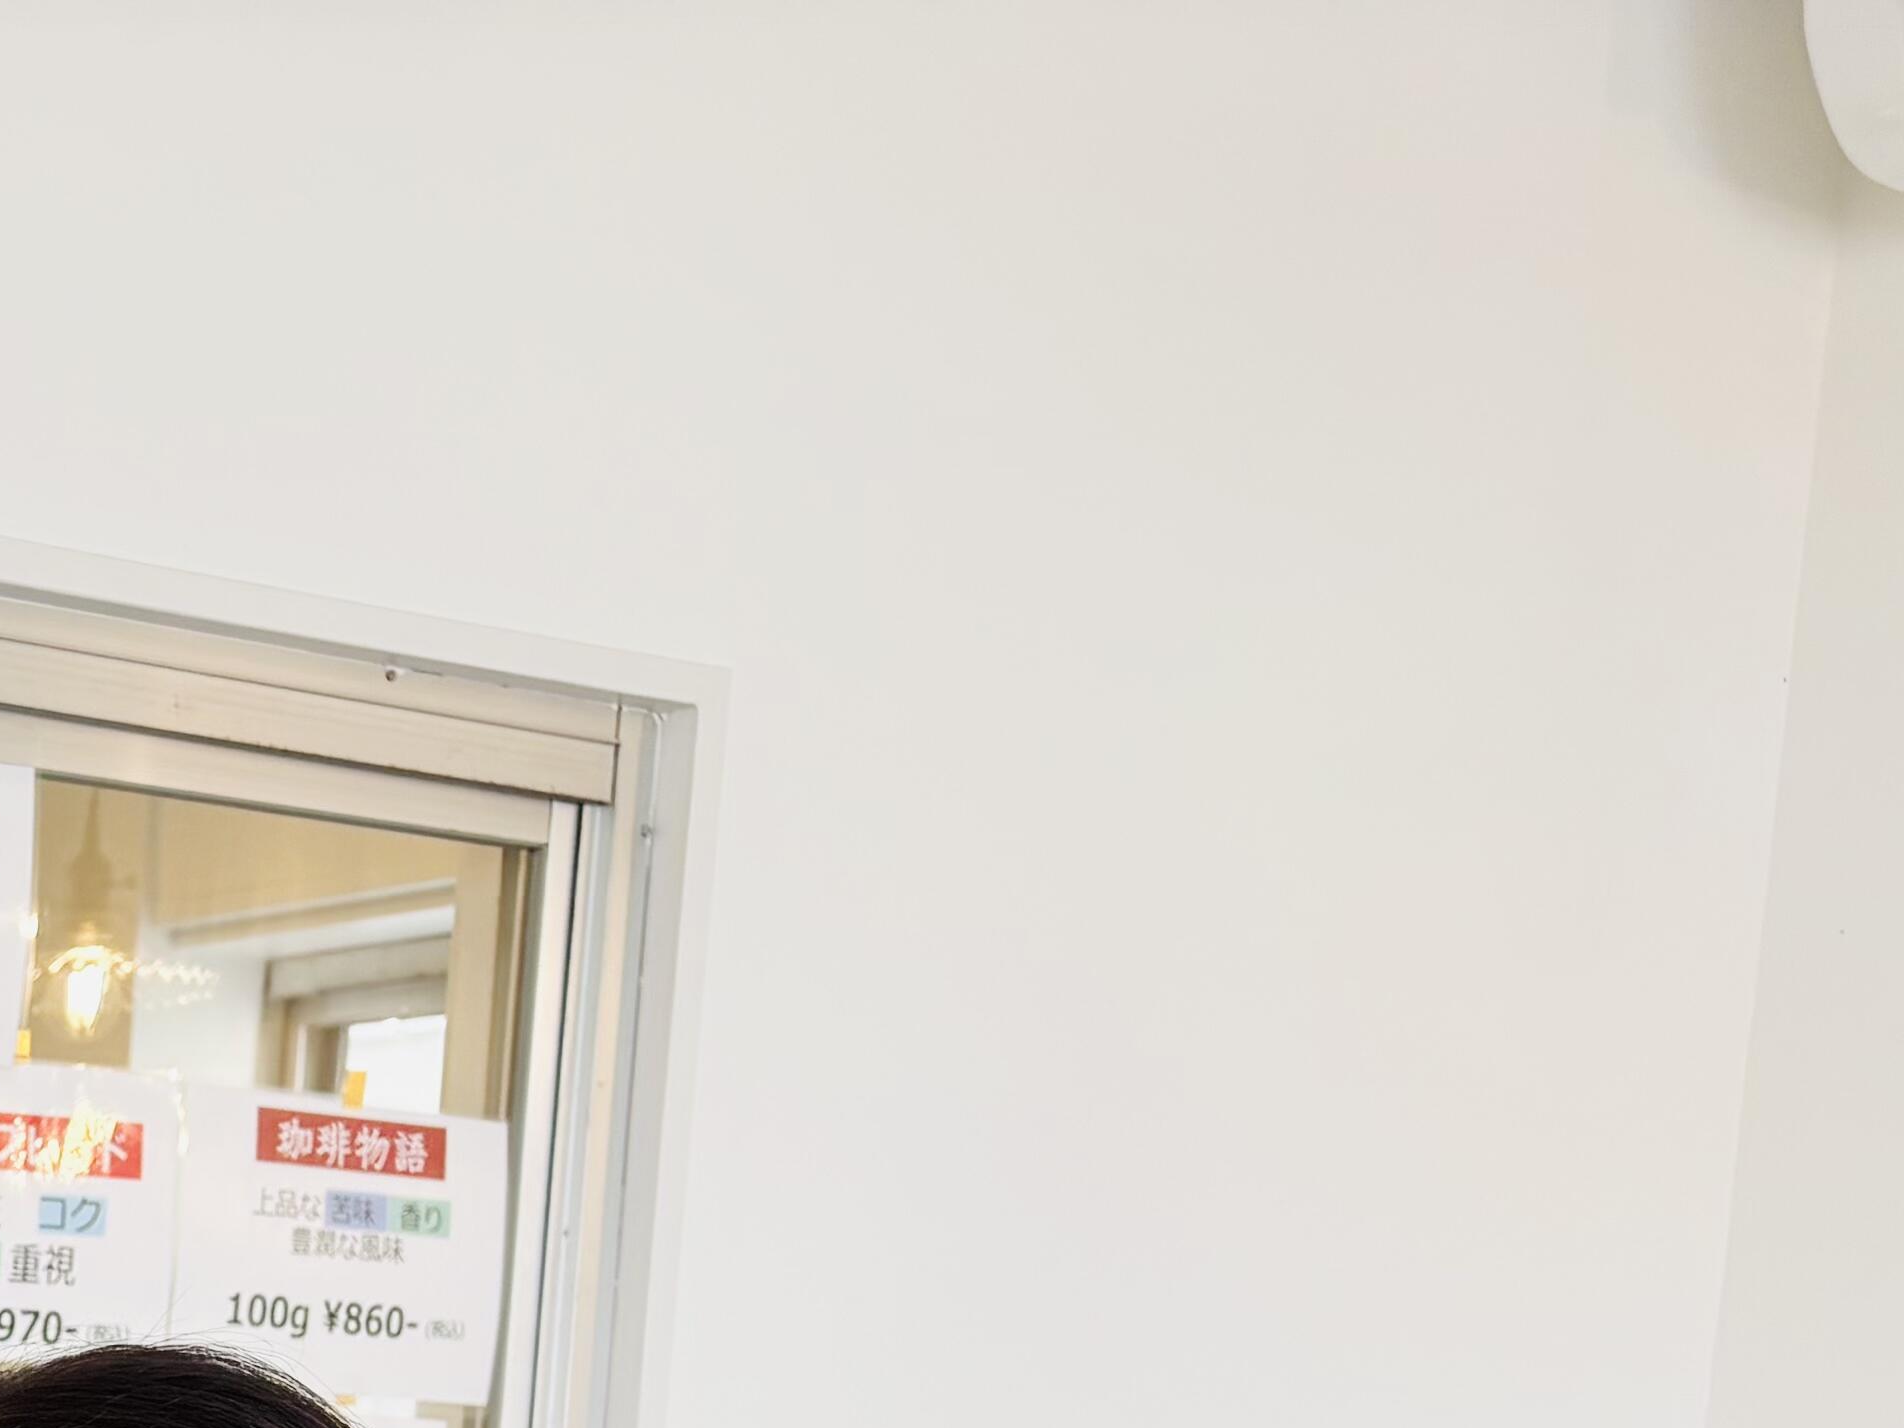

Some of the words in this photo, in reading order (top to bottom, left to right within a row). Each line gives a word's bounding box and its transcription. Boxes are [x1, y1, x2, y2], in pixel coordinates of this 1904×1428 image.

[276, 1117, 429, 1175] 珈琲物語
[39, 1196, 102, 1234] コク
[252, 1186, 322, 1221] 上品な
[331, 1193, 376, 1228] 苦味
[400, 1202, 443, 1234] 香り
[226, 1292, 310, 1339] 100g
